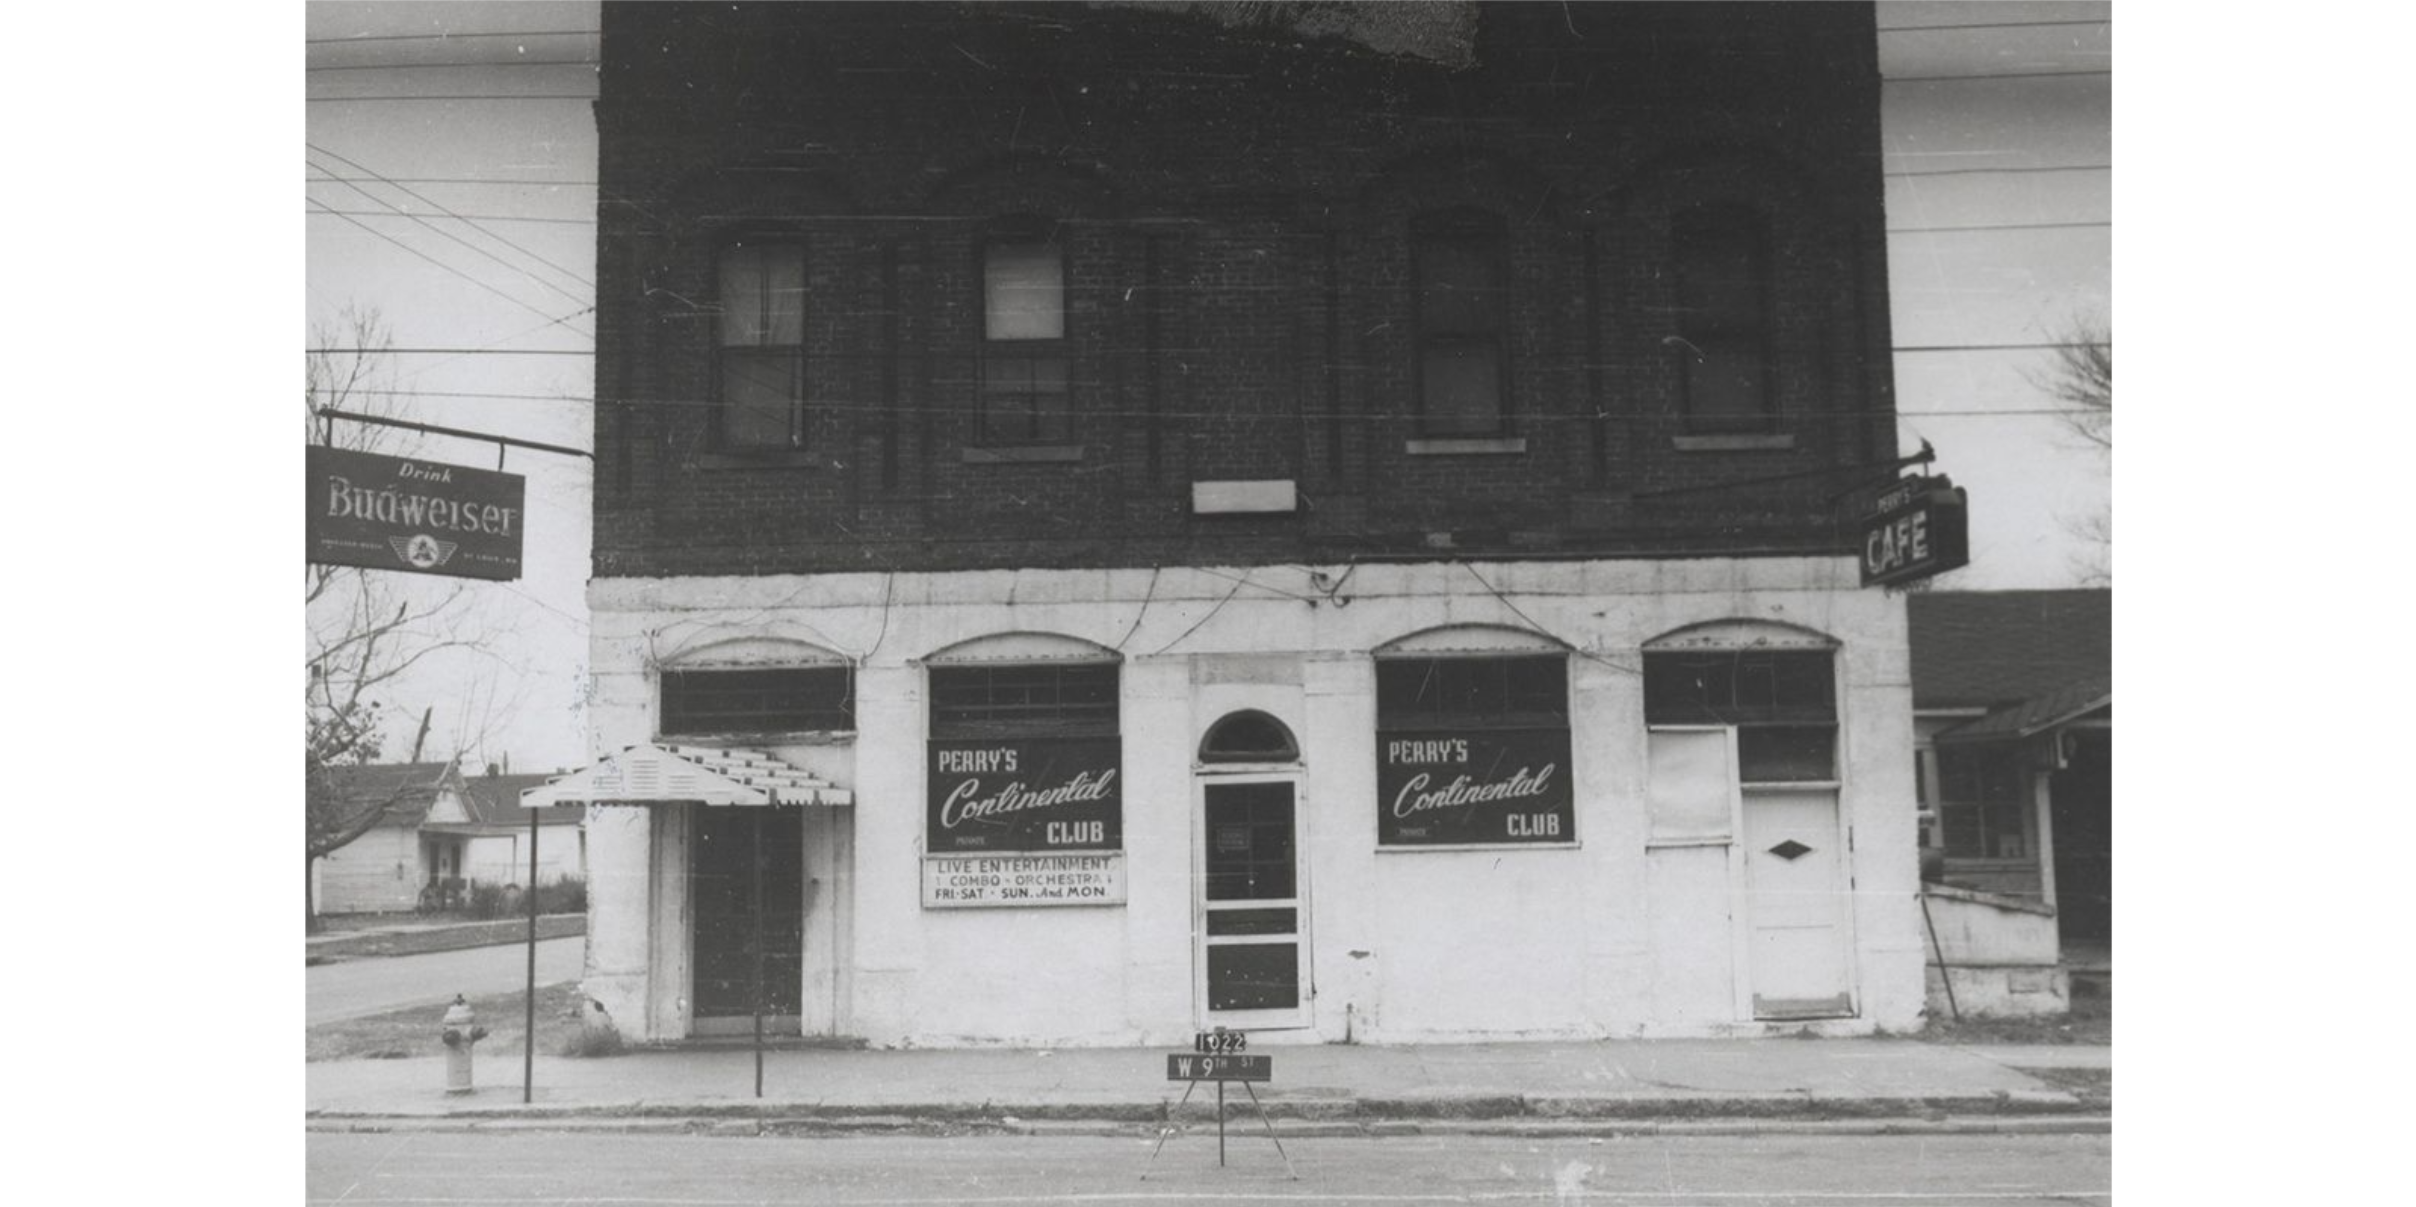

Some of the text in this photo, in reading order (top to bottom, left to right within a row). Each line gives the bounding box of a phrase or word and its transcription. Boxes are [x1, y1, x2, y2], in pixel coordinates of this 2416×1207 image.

[399, 462, 452, 483] Drink
[327, 475, 517, 536] Budweiser
[1867, 510, 1928, 574] CAFE
[939, 747, 1018, 773] PERRY'S
[1389, 738, 1468, 763] PERRY'S
[941, 768, 1116, 828] Continental
[1393, 762, 1556, 818] Continental
[1047, 821, 1104, 844] CLUB
[1507, 813, 1560, 836] CLUB
[938, 857, 1111, 874] LIVE ENTERTAINMENT
[950, 873, 1102, 886] COMBO ORCHESTRA
[1067, 886, 1105, 898] MON
[1200, 1034, 1244, 1051] 1022
[1178, 1057, 1193, 1078] W
[1241, 1056, 1254, 1067] ST
